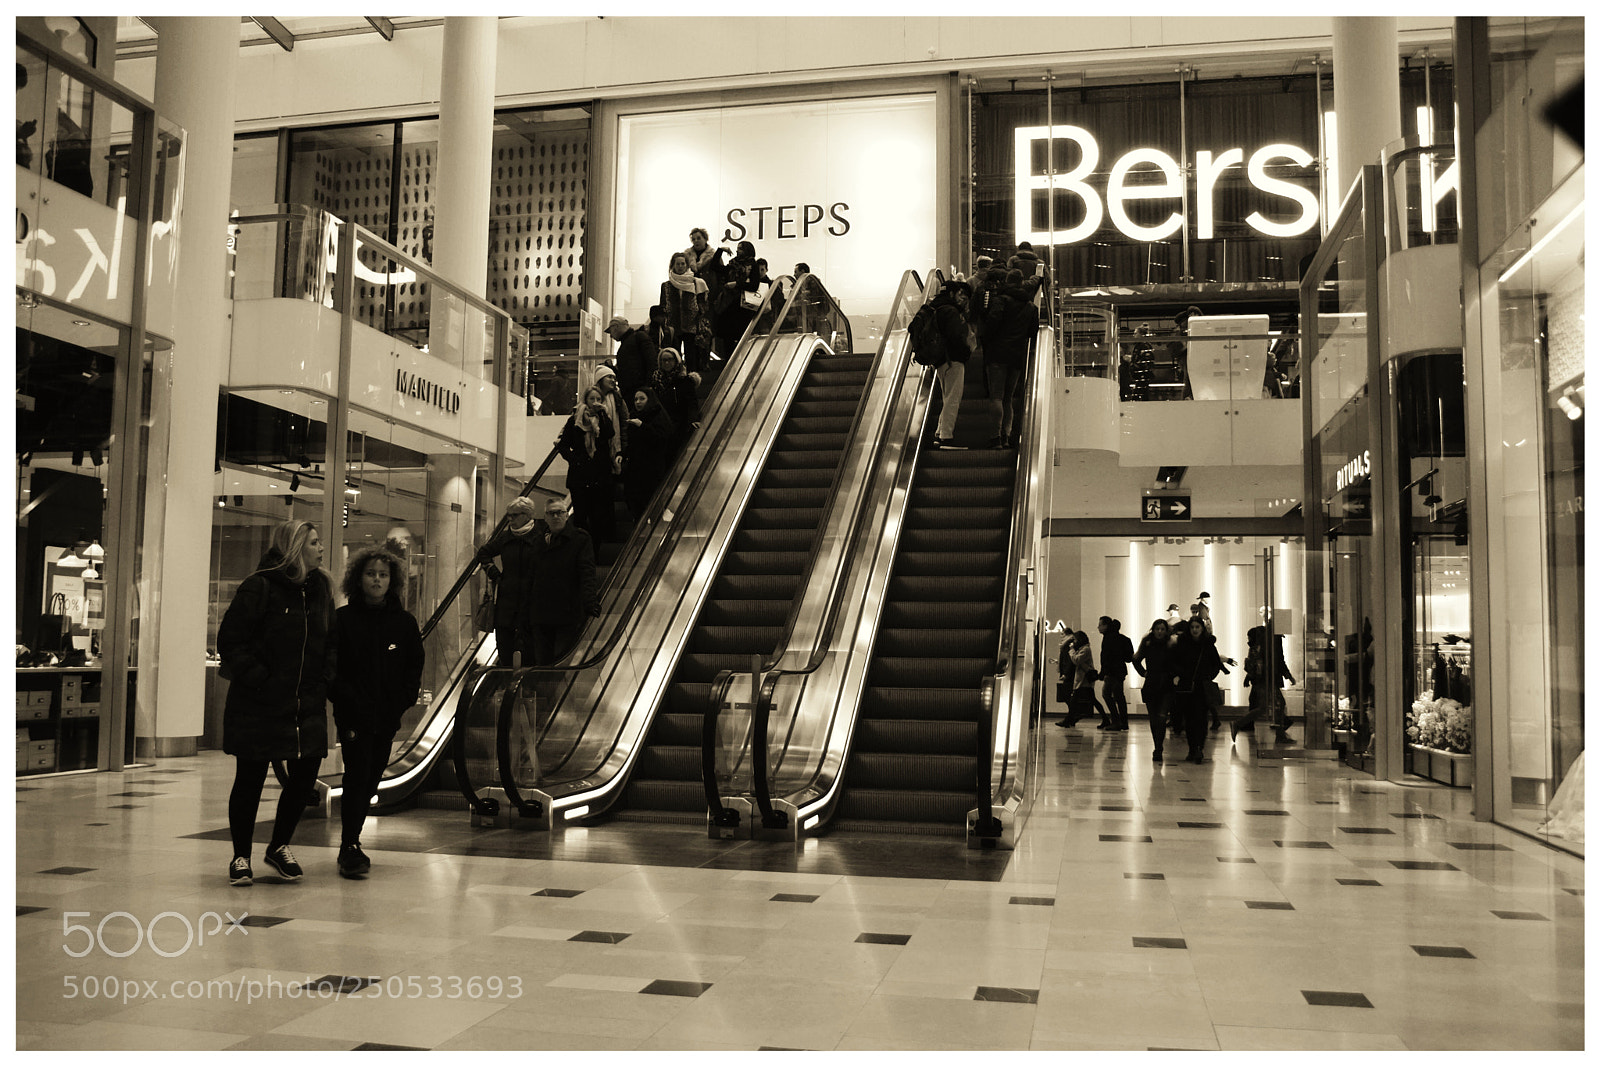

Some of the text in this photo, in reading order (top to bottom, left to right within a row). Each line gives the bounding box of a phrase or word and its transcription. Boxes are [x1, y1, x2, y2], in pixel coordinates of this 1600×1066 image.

[724, 202, 851, 242] STEPS
[396, 368, 460, 414] MANFIELD
[1336, 449, 1371, 492] RITUALS
